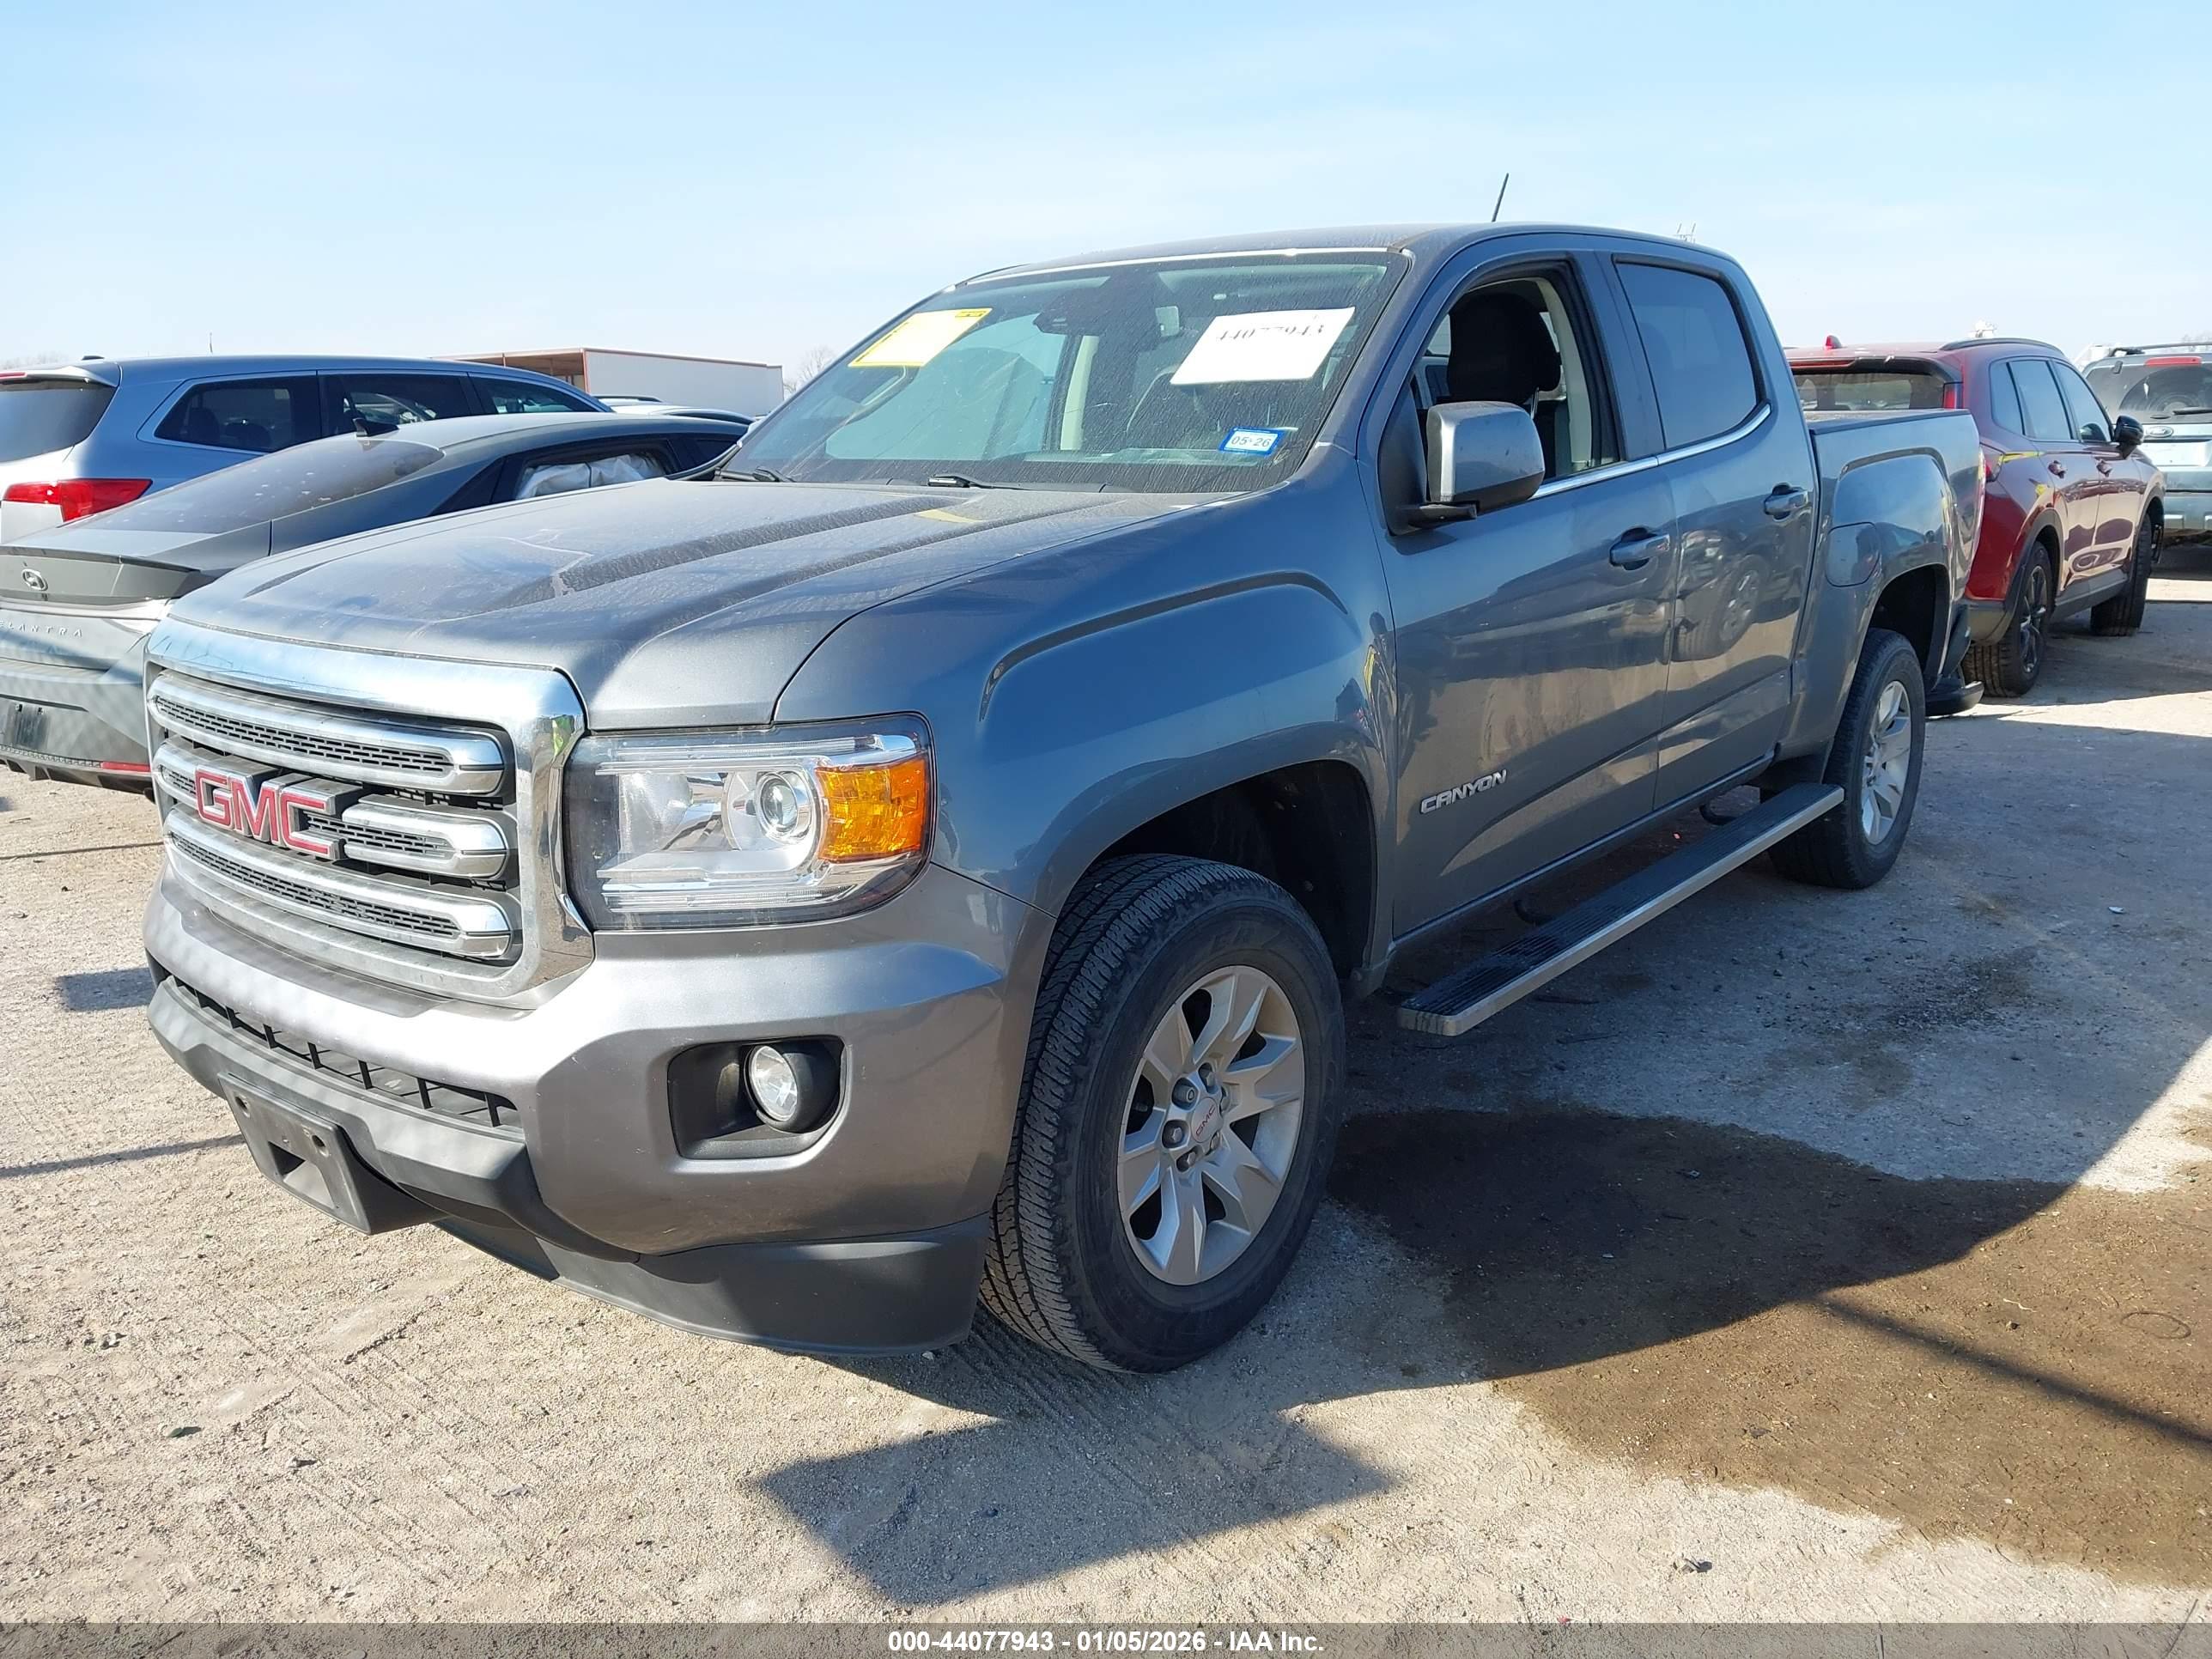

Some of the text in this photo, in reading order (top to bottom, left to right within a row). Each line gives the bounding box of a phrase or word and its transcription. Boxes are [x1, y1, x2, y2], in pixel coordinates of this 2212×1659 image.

[195, 765, 336, 860] GMC
[1420, 769, 1507, 813] CANYON
[1195, 1104, 1216, 1136] GMC
